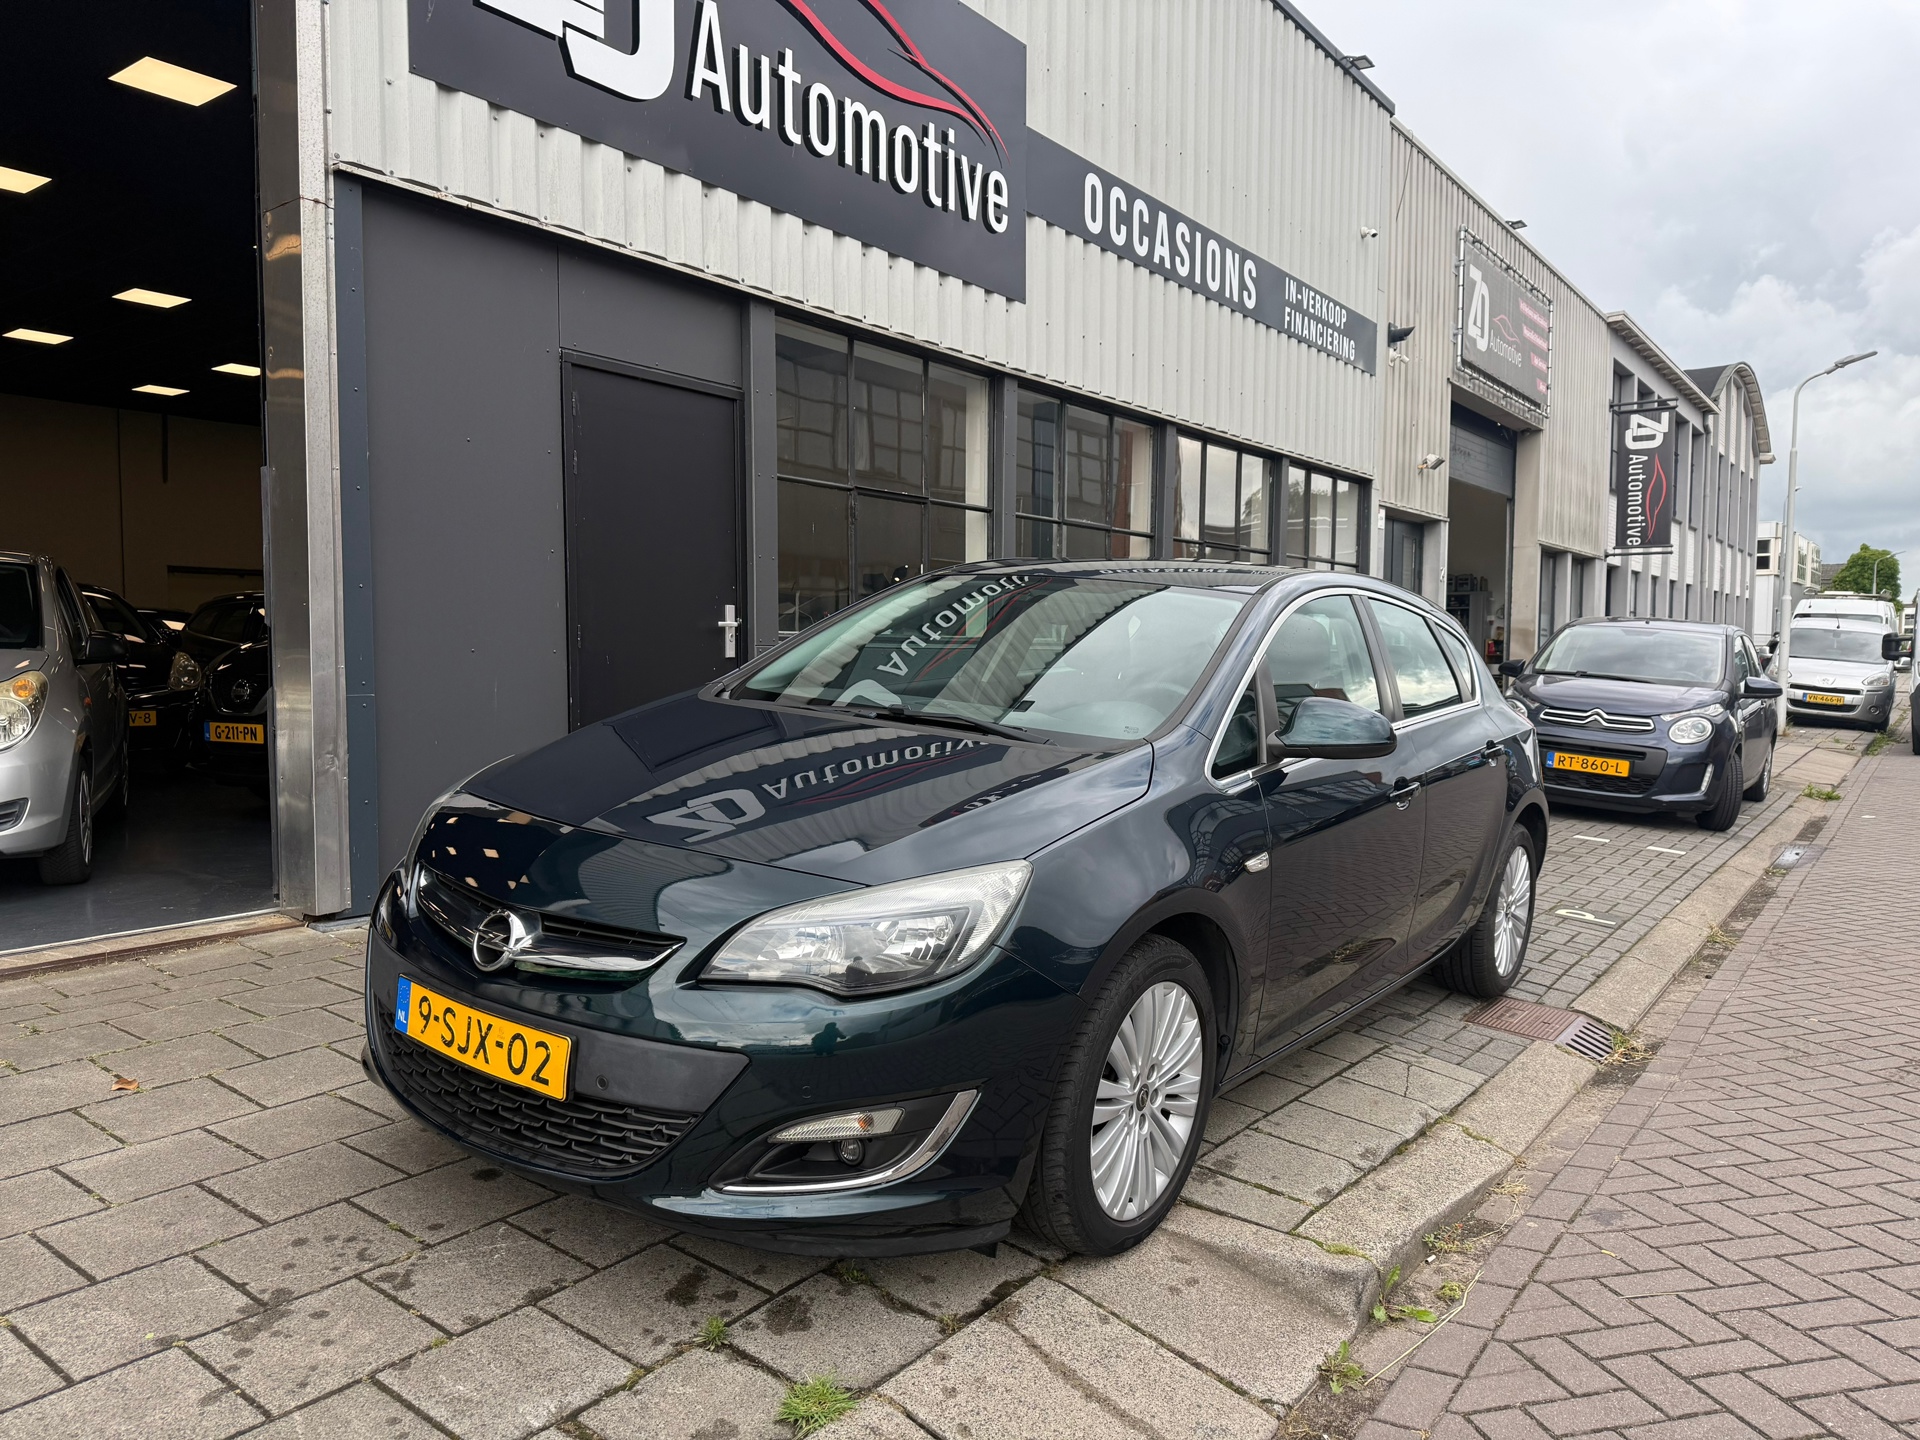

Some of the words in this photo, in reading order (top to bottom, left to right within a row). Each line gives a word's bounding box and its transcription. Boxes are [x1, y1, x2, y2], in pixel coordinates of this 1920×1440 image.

[691, 0, 1010, 234] Automotive
[1084, 172, 1257, 310] OCCASIONS
[1284, 276, 1348, 330] IN-VERKOOP
[1284, 306, 1356, 362] FINANCIERING
[1489, 328, 1523, 368] Automotive
[1626, 454, 1649, 546] Automotive
[1808, 693, 1842, 704] VN-466-H
[214, 725, 258, 742] G-211-PN
[397, 1008, 407, 1024] NL
[418, 994, 551, 1087] 9-SJX-02
